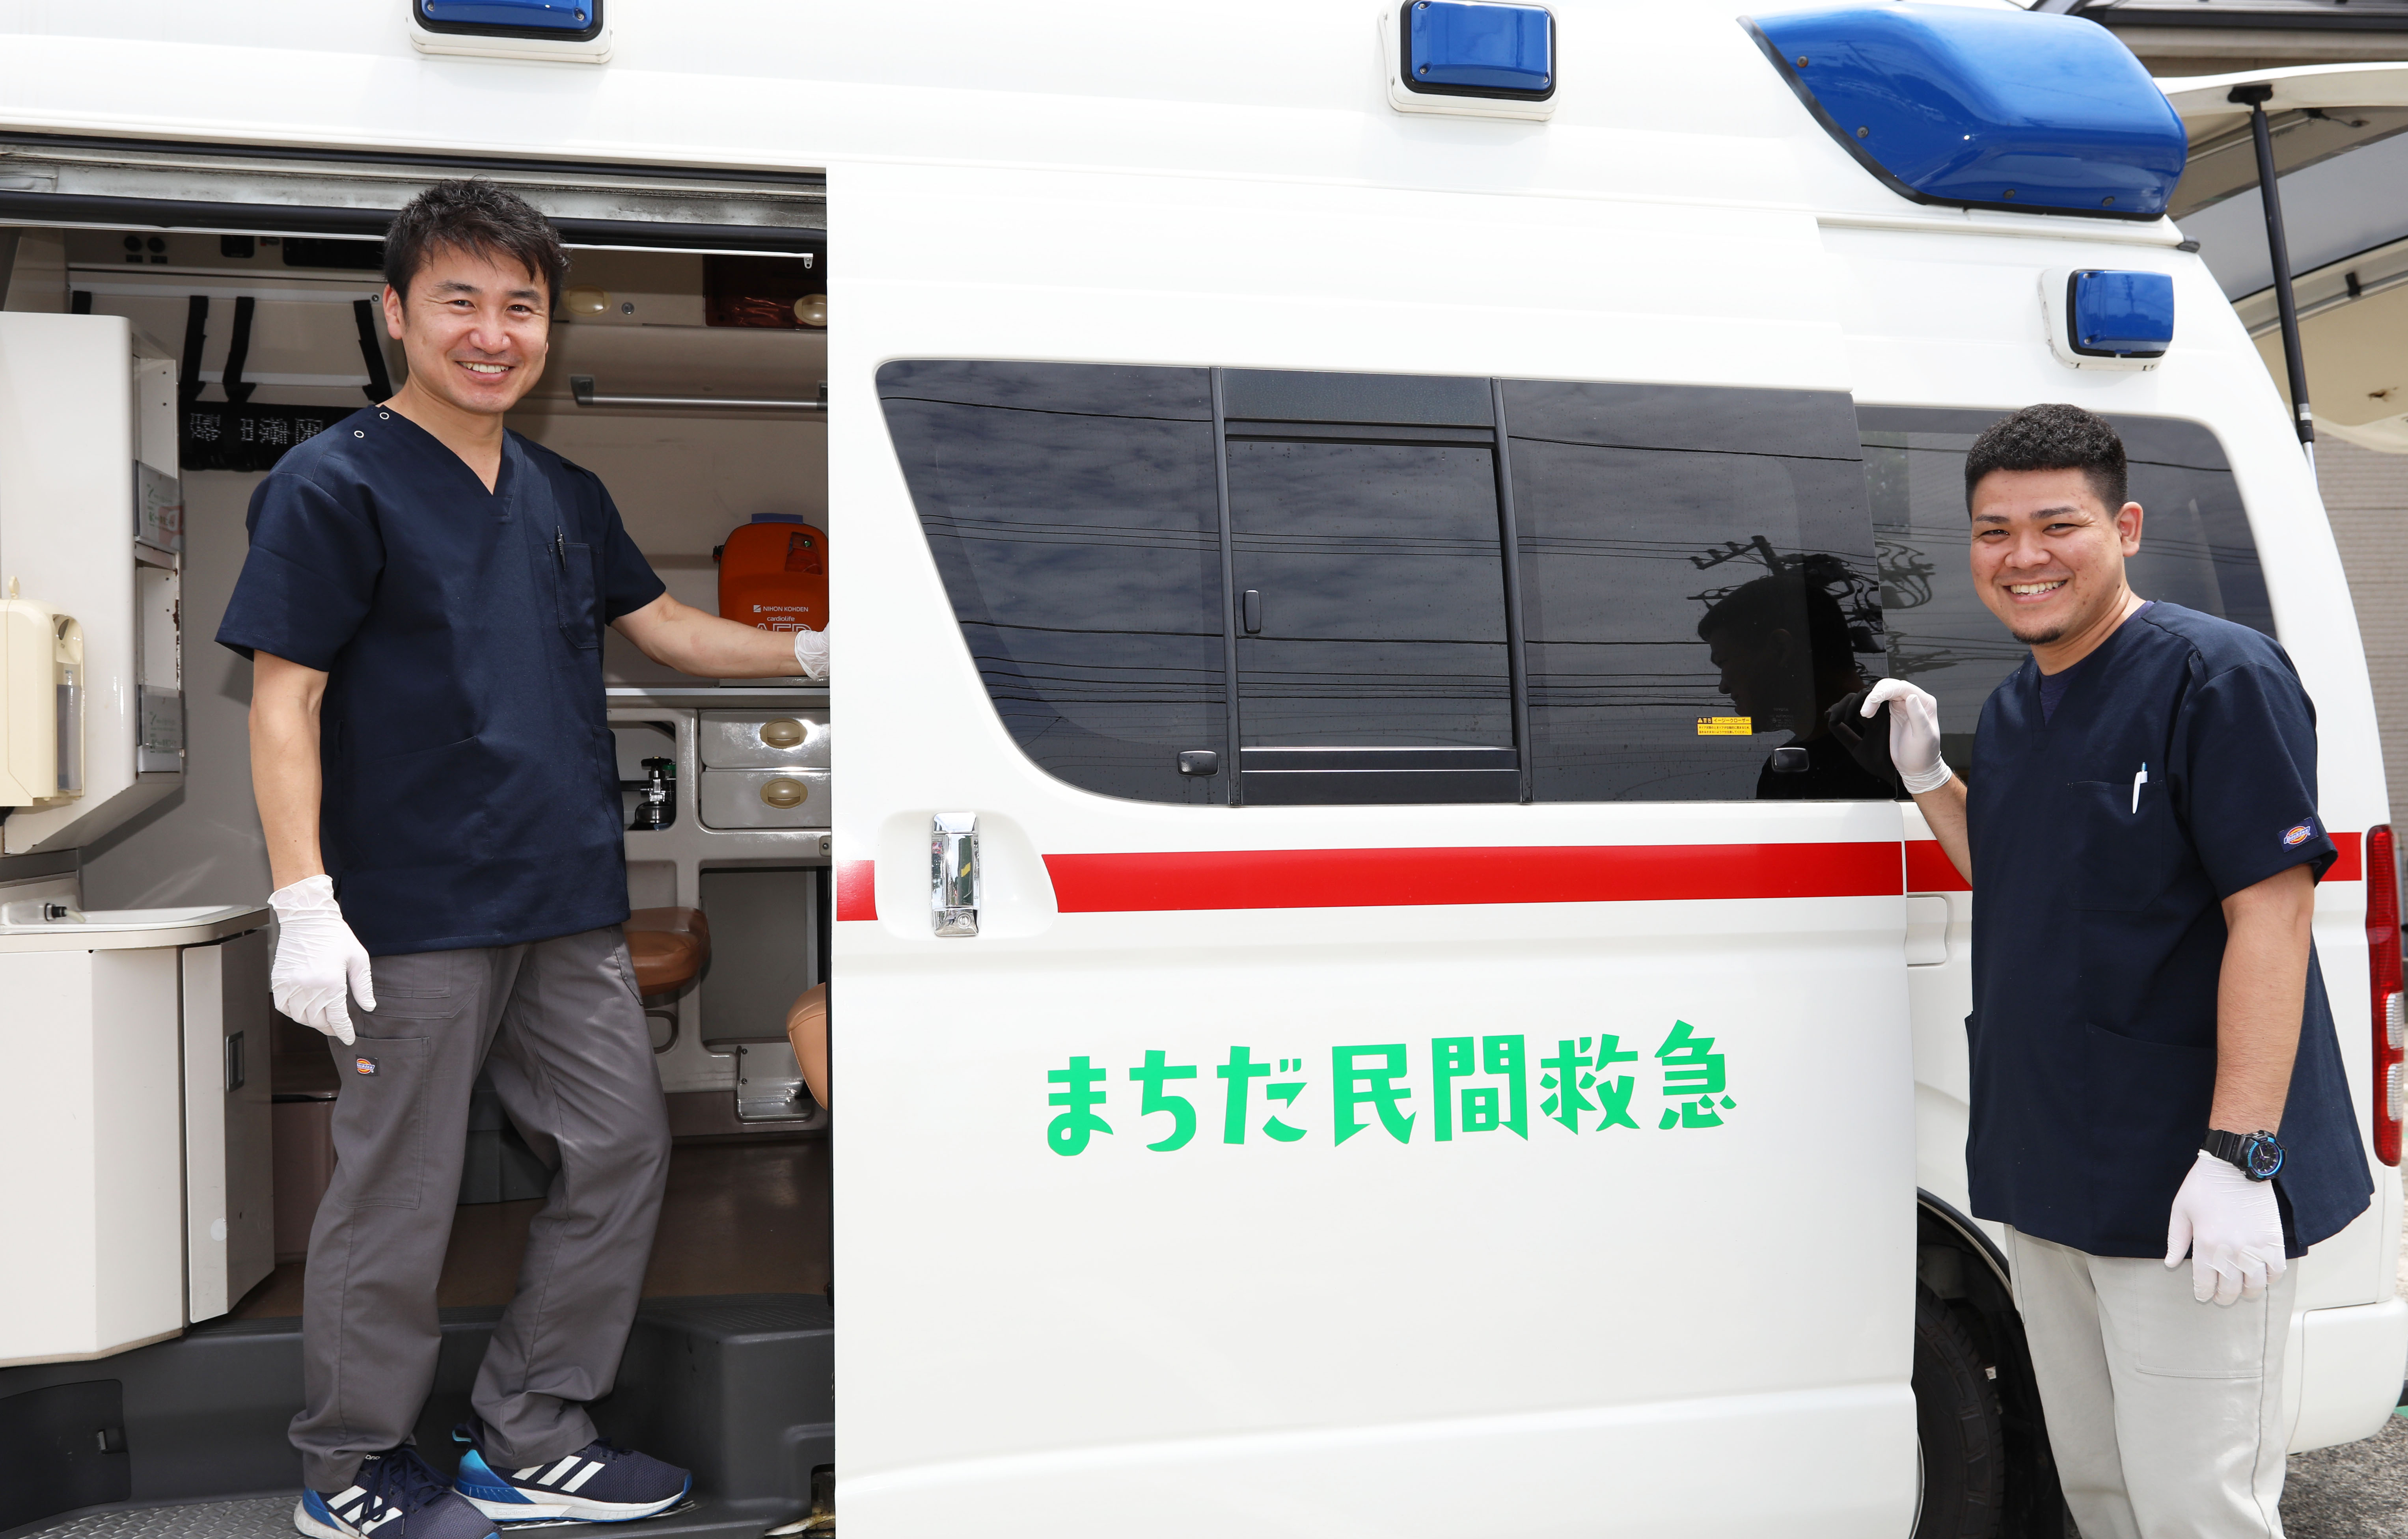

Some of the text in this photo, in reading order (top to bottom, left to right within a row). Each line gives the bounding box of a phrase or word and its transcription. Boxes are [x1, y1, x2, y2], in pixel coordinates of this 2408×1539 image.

[2286, 828, 2309, 842] Dickies
[1048, 1020, 1736, 1156] まちだ民間救急
